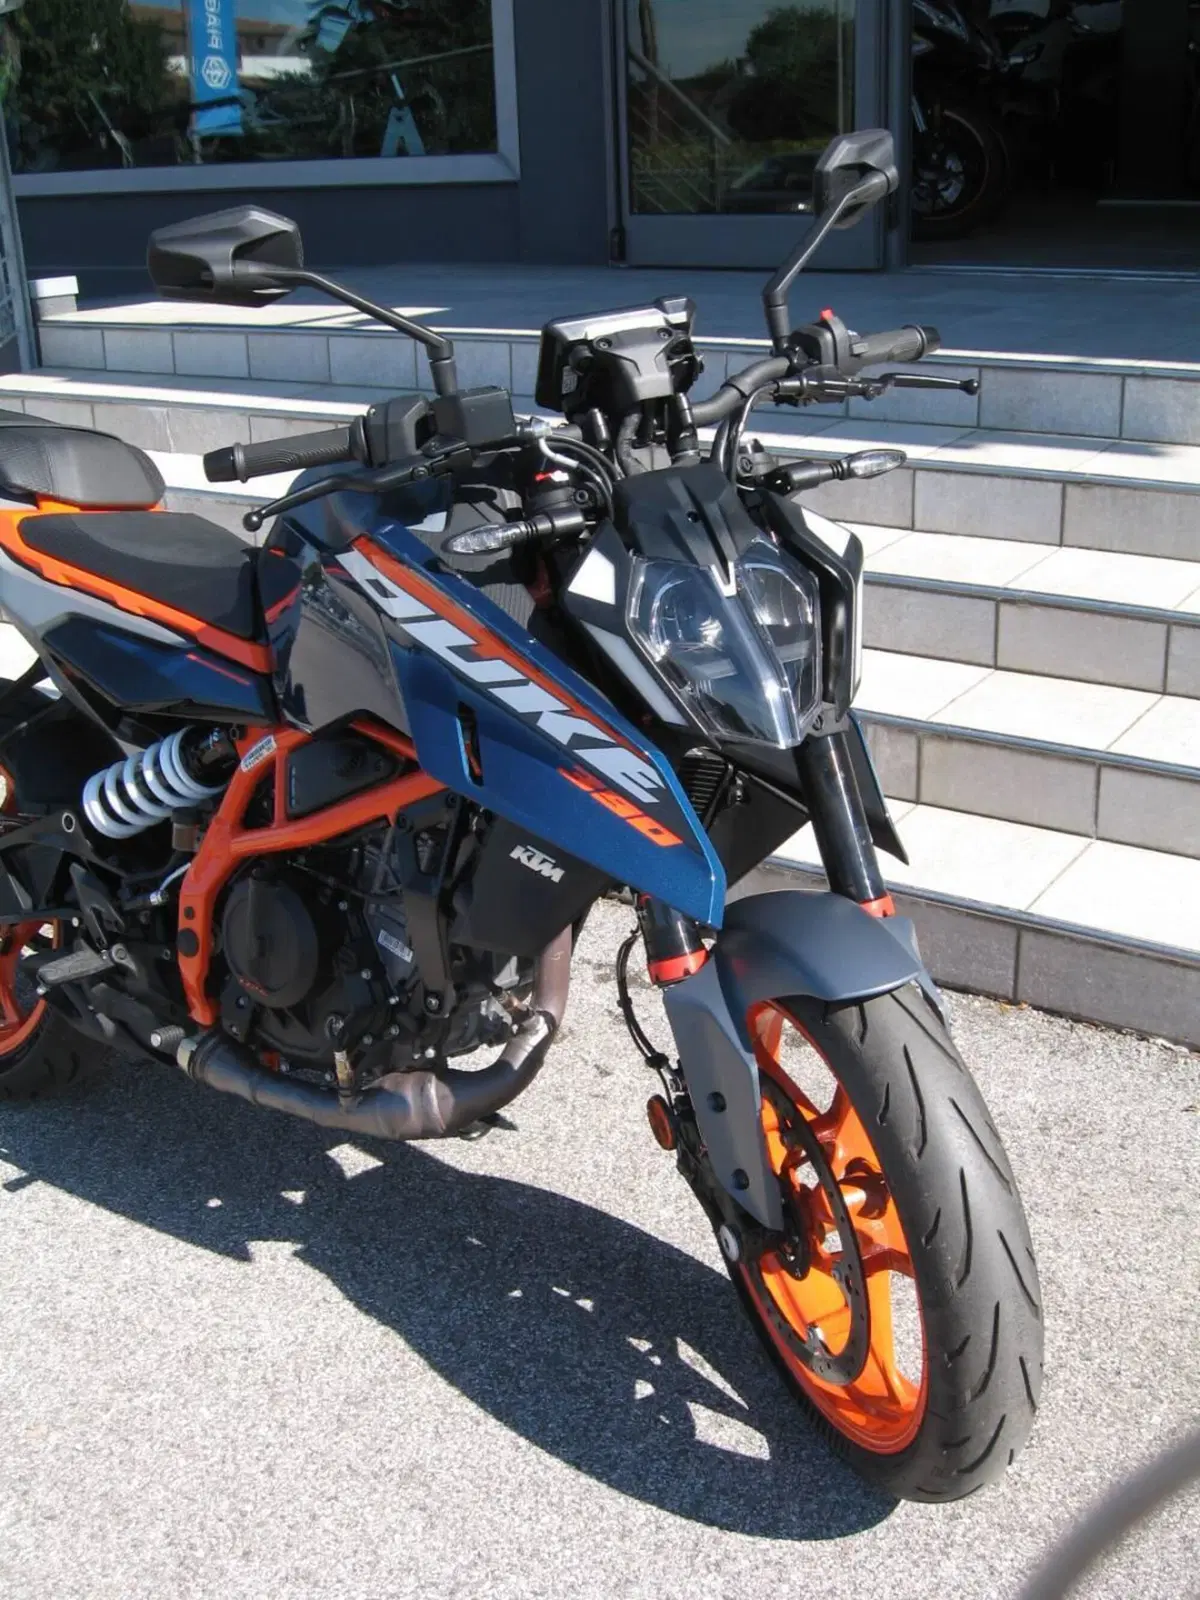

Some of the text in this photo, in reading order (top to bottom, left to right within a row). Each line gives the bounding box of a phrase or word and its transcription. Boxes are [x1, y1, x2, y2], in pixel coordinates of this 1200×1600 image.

[336, 550, 666, 803] DUKE
[556, 765, 683, 847] 390
[509, 845, 565, 883] KTM
